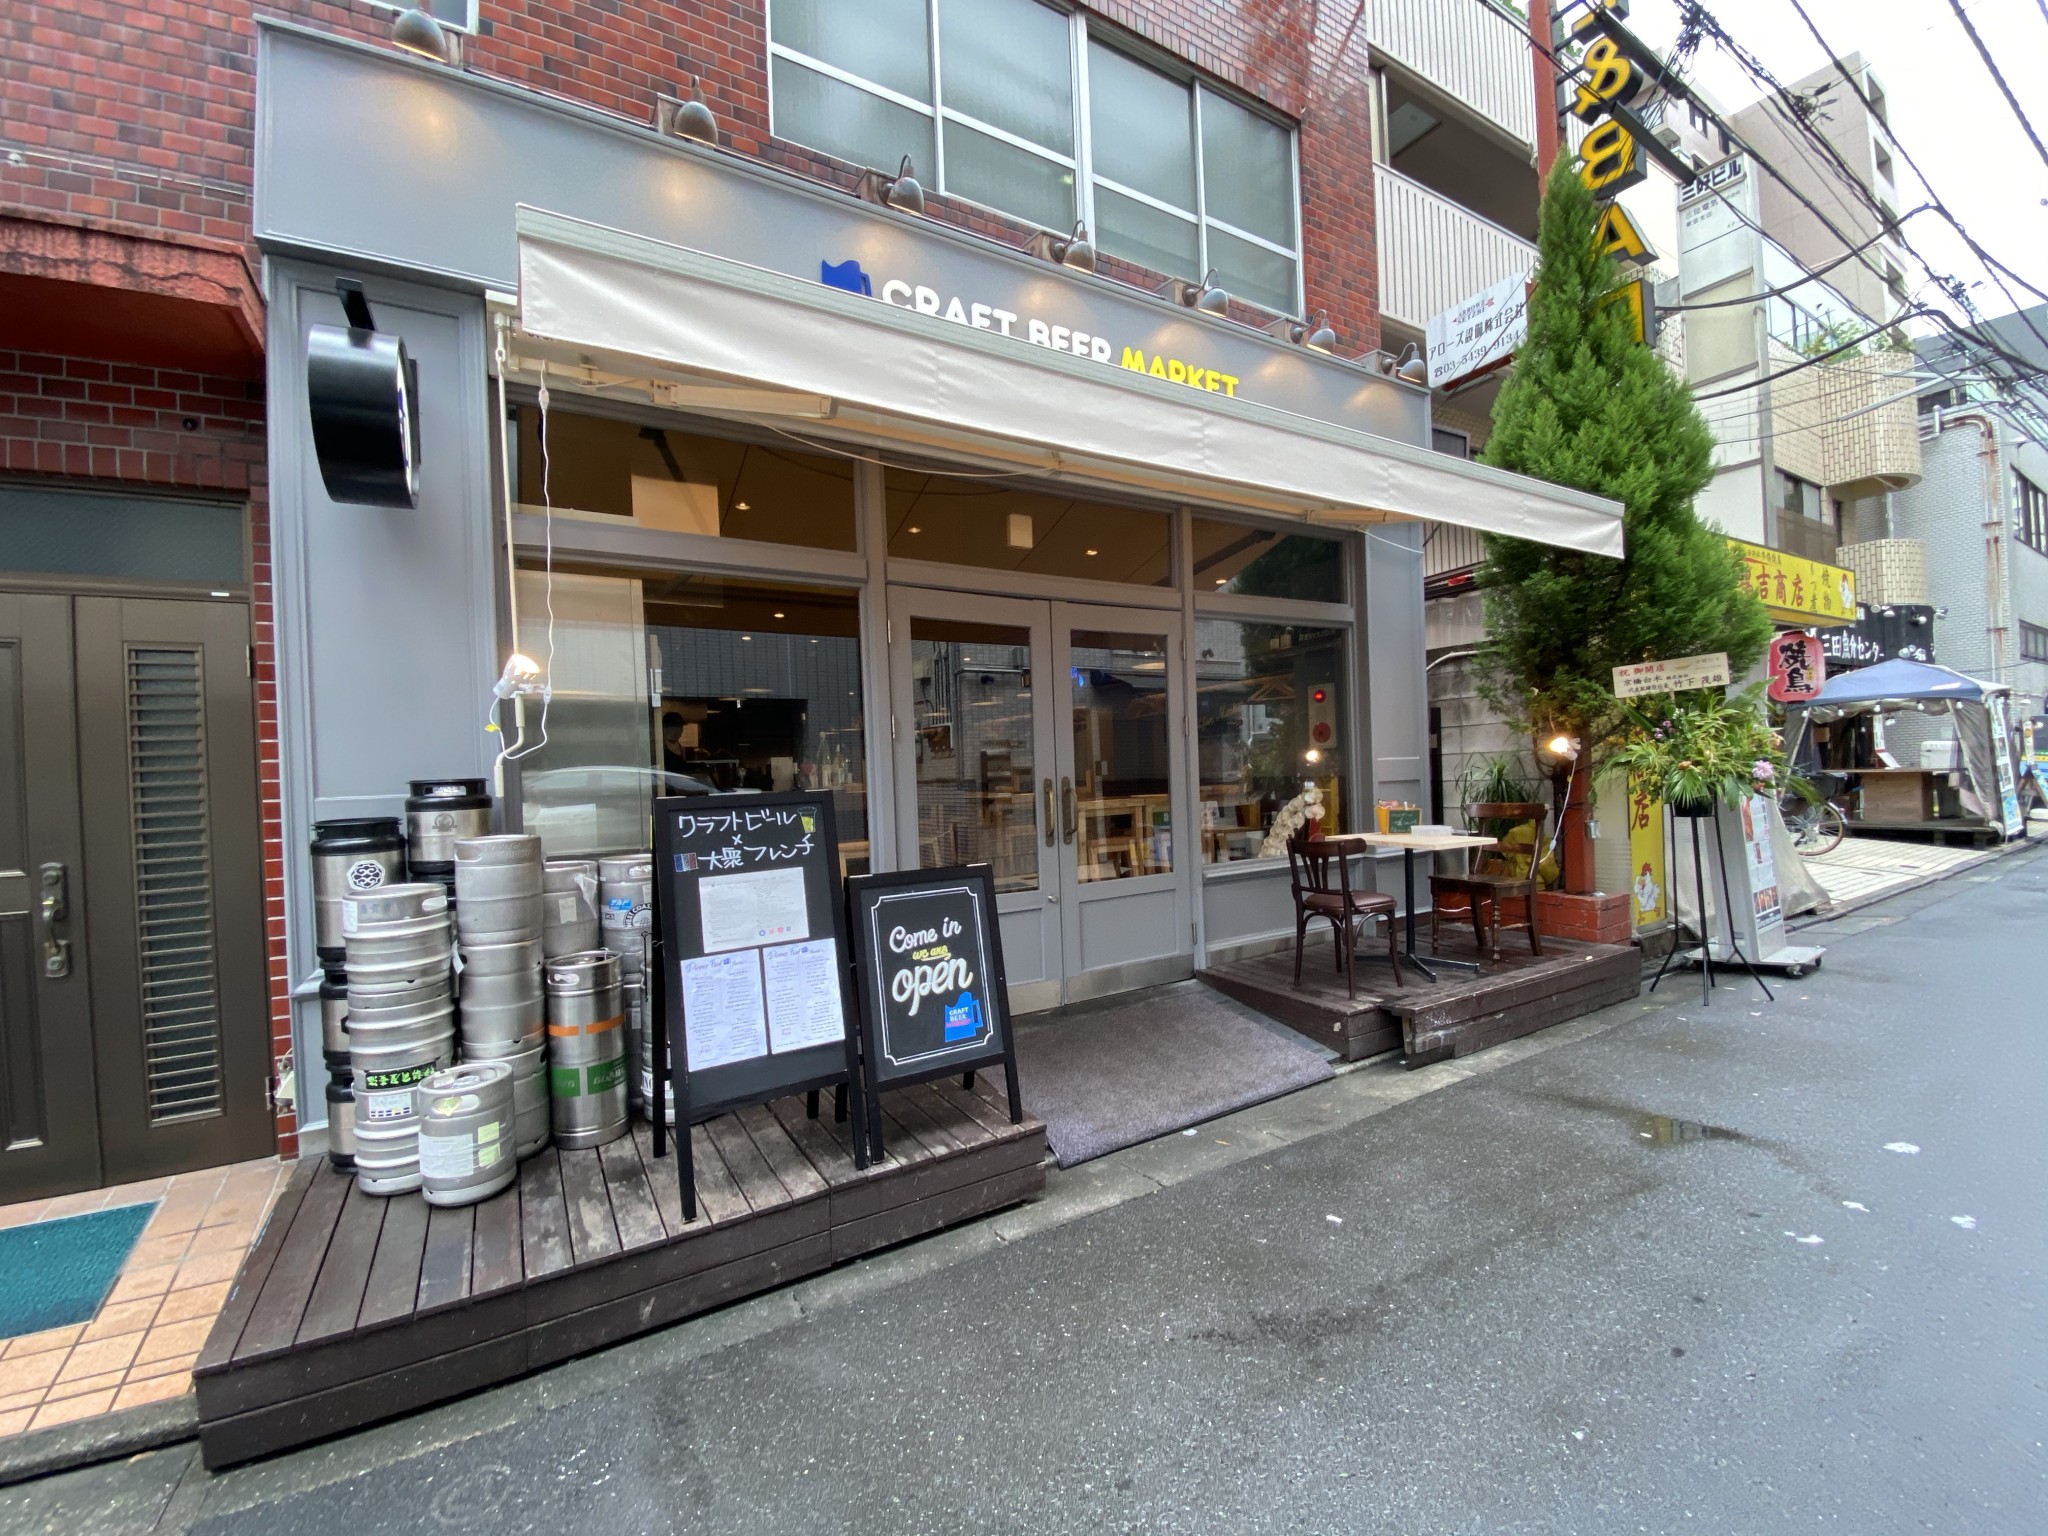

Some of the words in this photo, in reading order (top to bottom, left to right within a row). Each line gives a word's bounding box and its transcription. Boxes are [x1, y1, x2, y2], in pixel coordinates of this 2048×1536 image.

[882, 279, 1018, 337] CRAFT
[1028, 318, 1112, 363] BEER
[1121, 345, 1240, 398] MARKET
[1779, 639, 1814, 693] 焼鳥
[678, 808, 797, 838] クラフトビール
[698, 833, 815, 870] 大衆フレンチ
[633, 902, 653, 914] COAS
[889, 926, 938, 953] Come
[942, 916, 962, 938] in
[912, 949, 930, 960] we
[930, 945, 949, 957] are
[892, 957, 974, 1017] open
[949, 1006, 969, 1016] CRAFT
